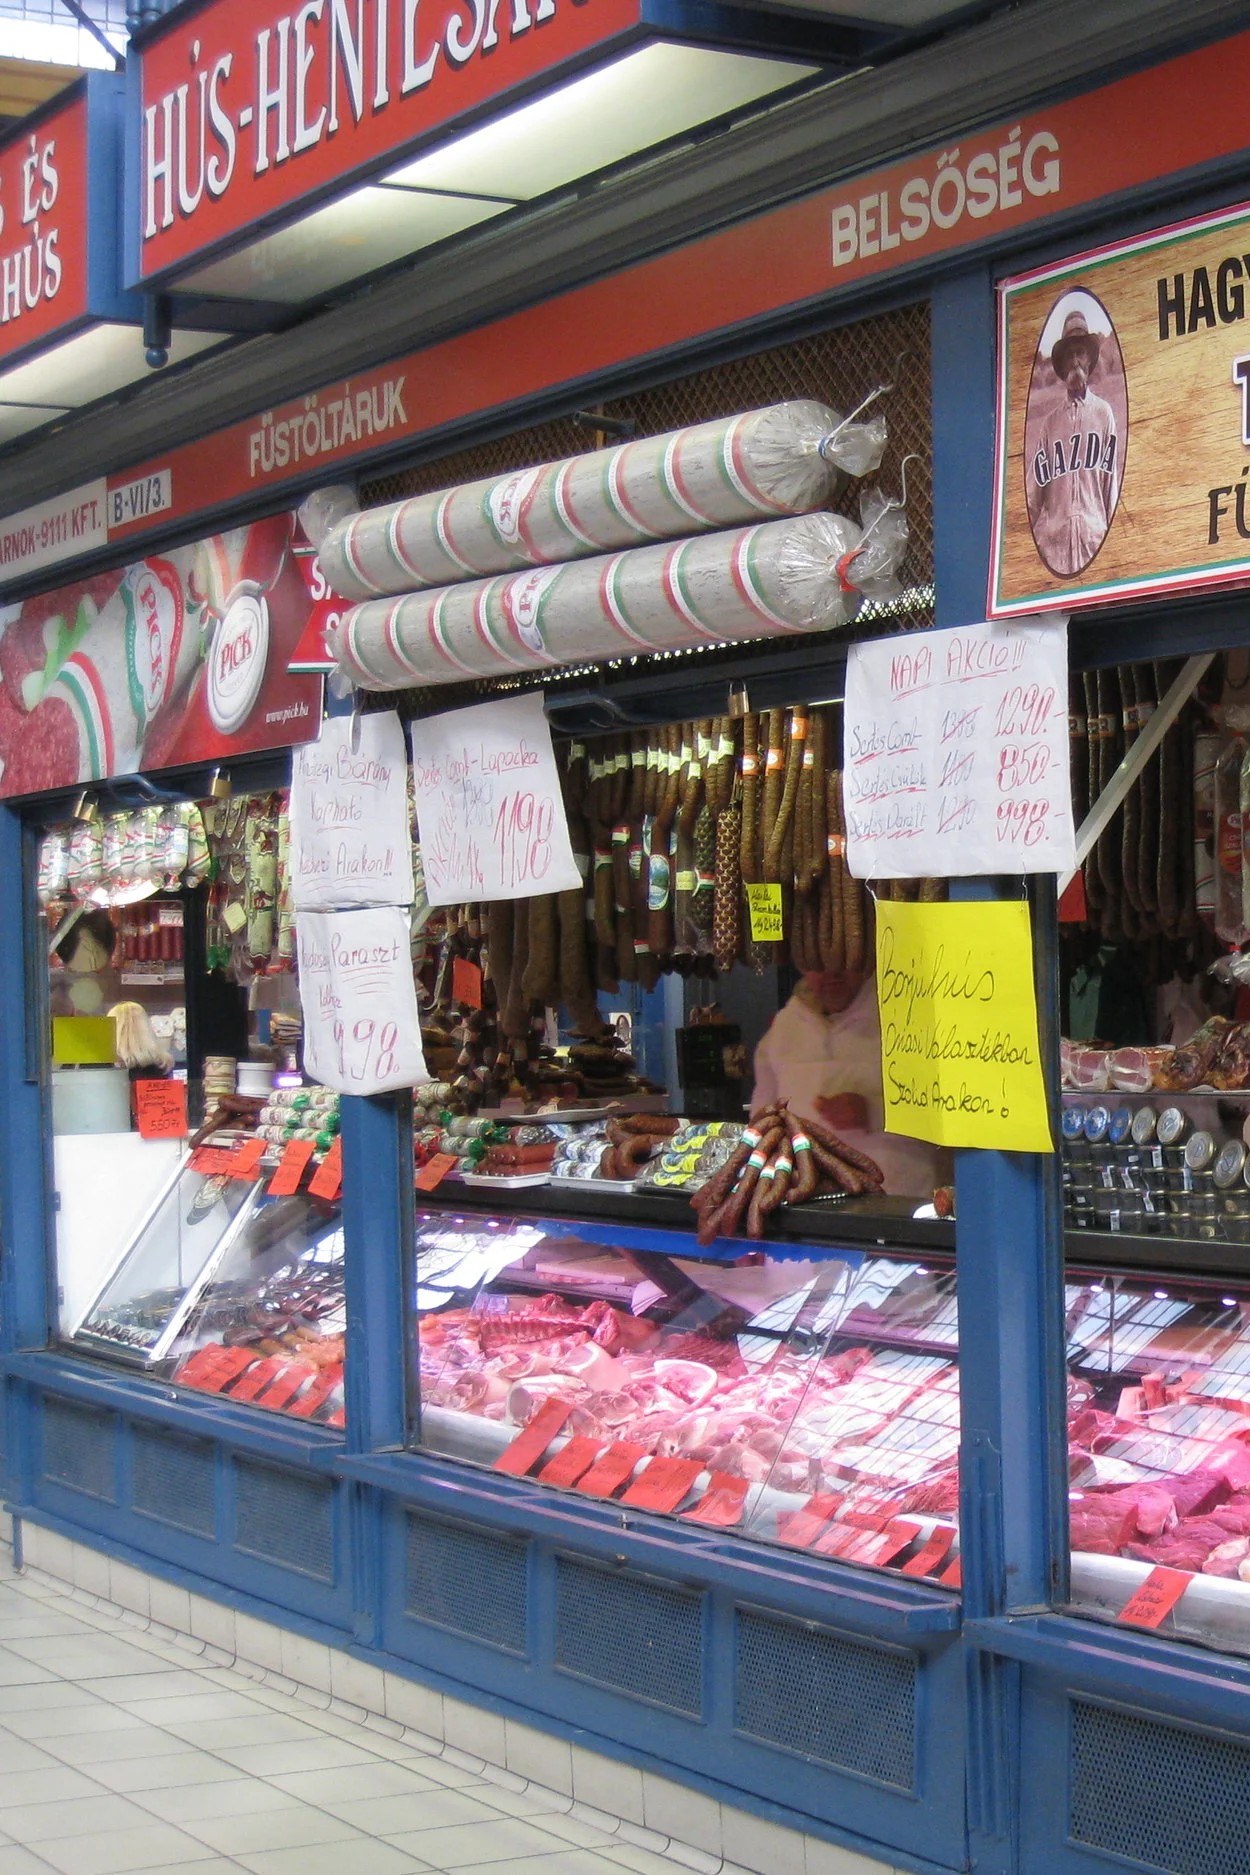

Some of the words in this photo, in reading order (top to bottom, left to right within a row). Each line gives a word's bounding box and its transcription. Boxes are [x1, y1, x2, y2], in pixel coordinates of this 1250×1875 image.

[832, 125, 1060, 267] BELSŐSÉG
[249, 376, 408, 478] FÜSTÖLTÁRUK
[1032, 432, 1118, 490] GAZDA
[218, 625, 254, 682] PICK
[889, 645, 933, 693] NAPI
